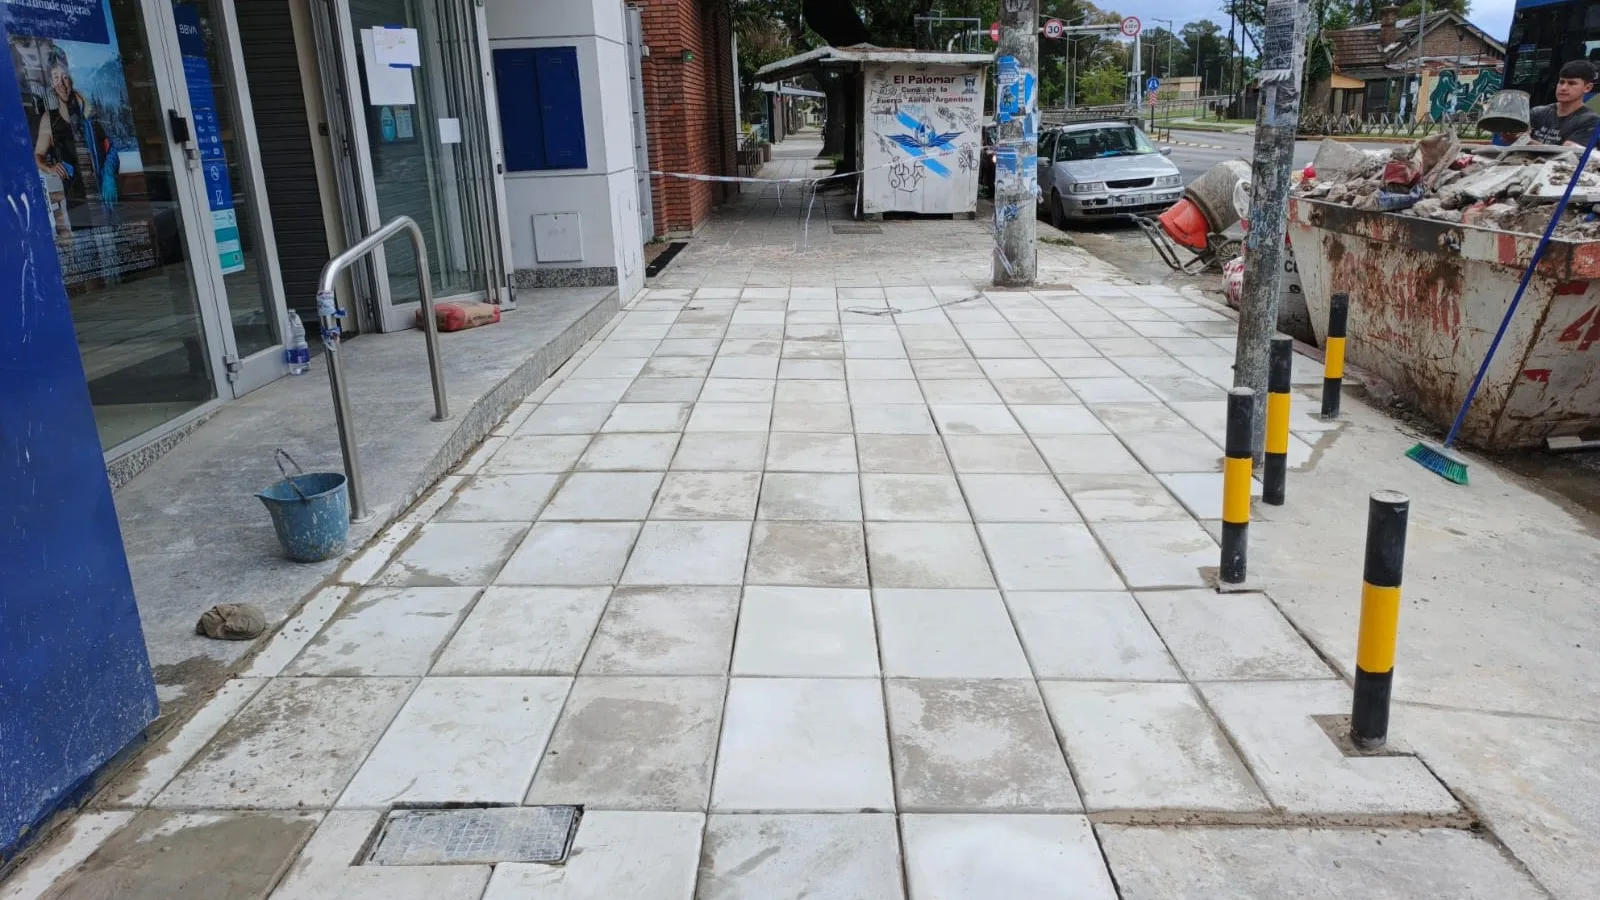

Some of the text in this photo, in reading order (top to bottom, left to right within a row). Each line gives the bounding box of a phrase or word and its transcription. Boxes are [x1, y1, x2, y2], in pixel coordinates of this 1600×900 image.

[179, 24, 198, 34] BBVA
[1047, 25, 1060, 34] 30
[894, 75, 957, 84] El Palomar
[936, 96, 973, 104] Argentina
